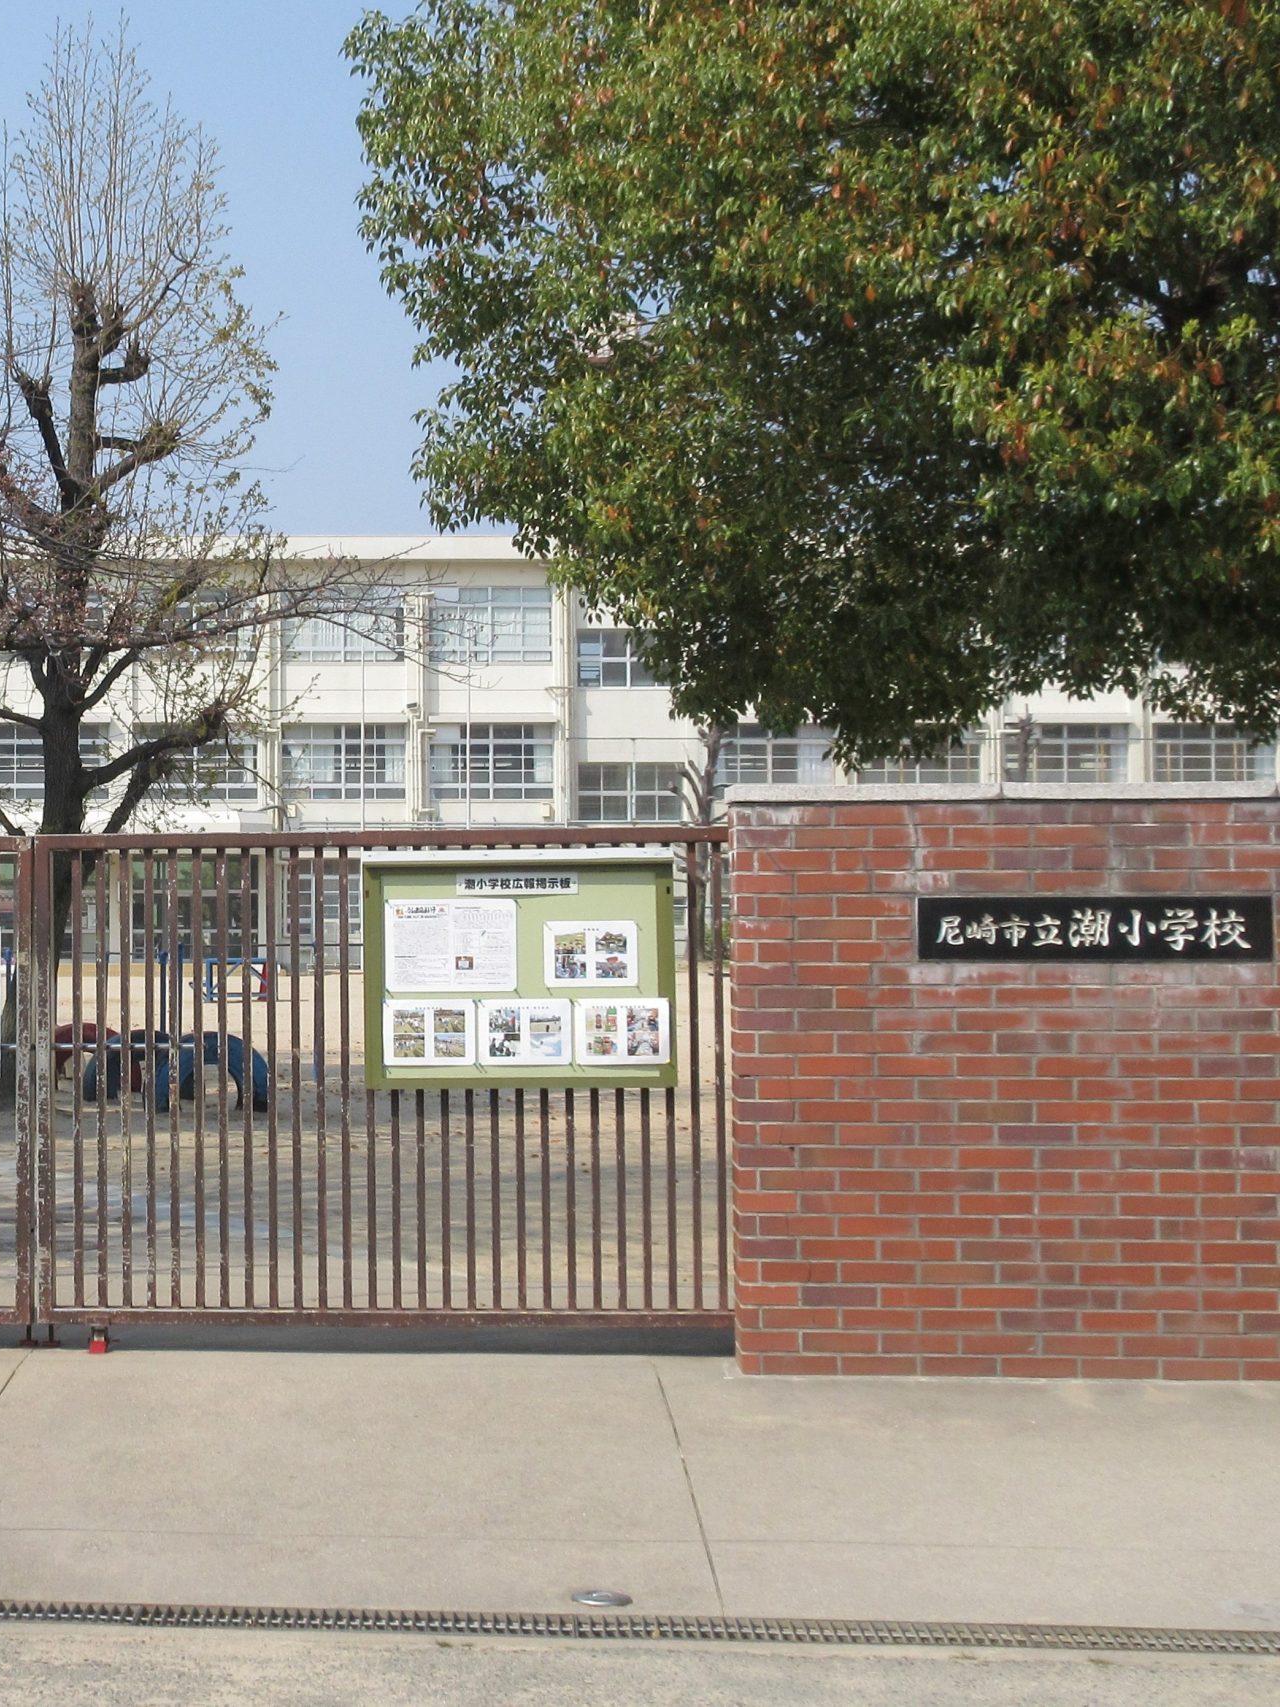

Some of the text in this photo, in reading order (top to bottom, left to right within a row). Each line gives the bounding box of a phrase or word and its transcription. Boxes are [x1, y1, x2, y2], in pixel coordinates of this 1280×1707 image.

[464, 878, 571, 890] 潮小学校広報掲示板
[935, 907, 1252, 951] 尼崎市立潮小学校
